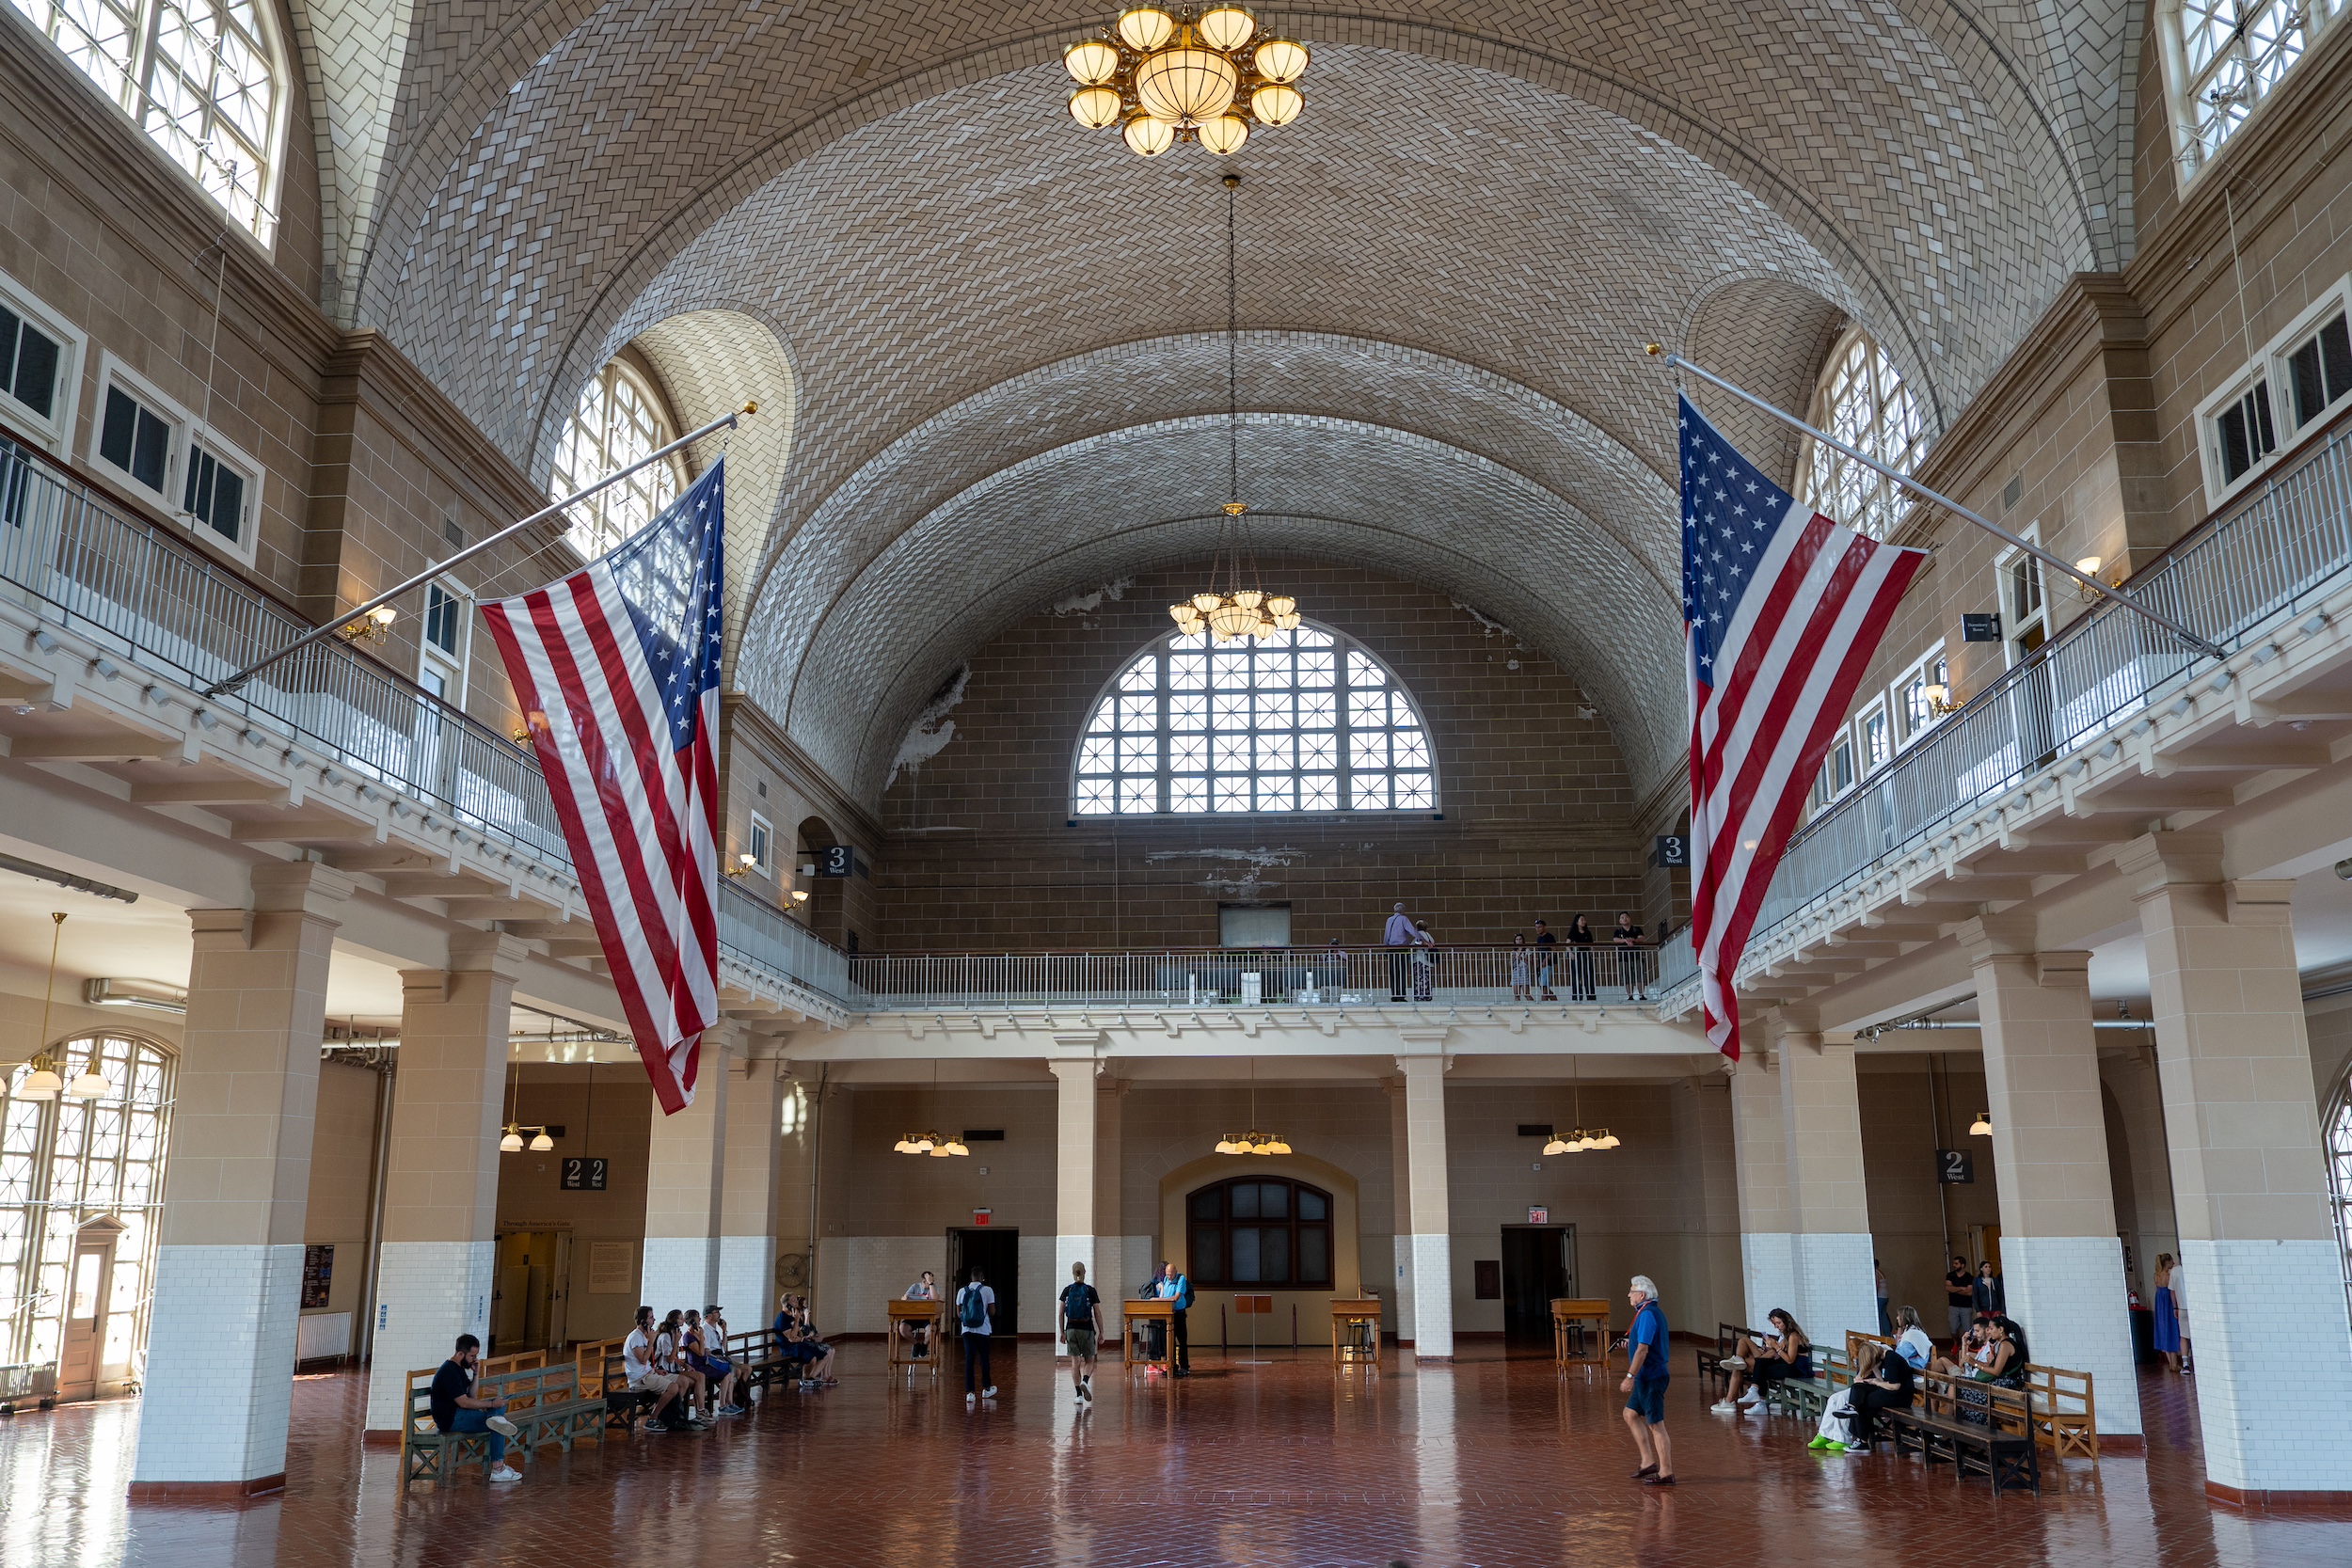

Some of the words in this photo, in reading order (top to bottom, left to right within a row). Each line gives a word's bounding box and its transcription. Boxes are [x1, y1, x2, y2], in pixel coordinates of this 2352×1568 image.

[829, 847, 845, 867] 3
[1665, 837, 1682, 858] 3
[566, 1160, 581, 1180] 2
[592, 1160, 603, 1180] 2
[1946, 1151, 1963, 1173] 2
